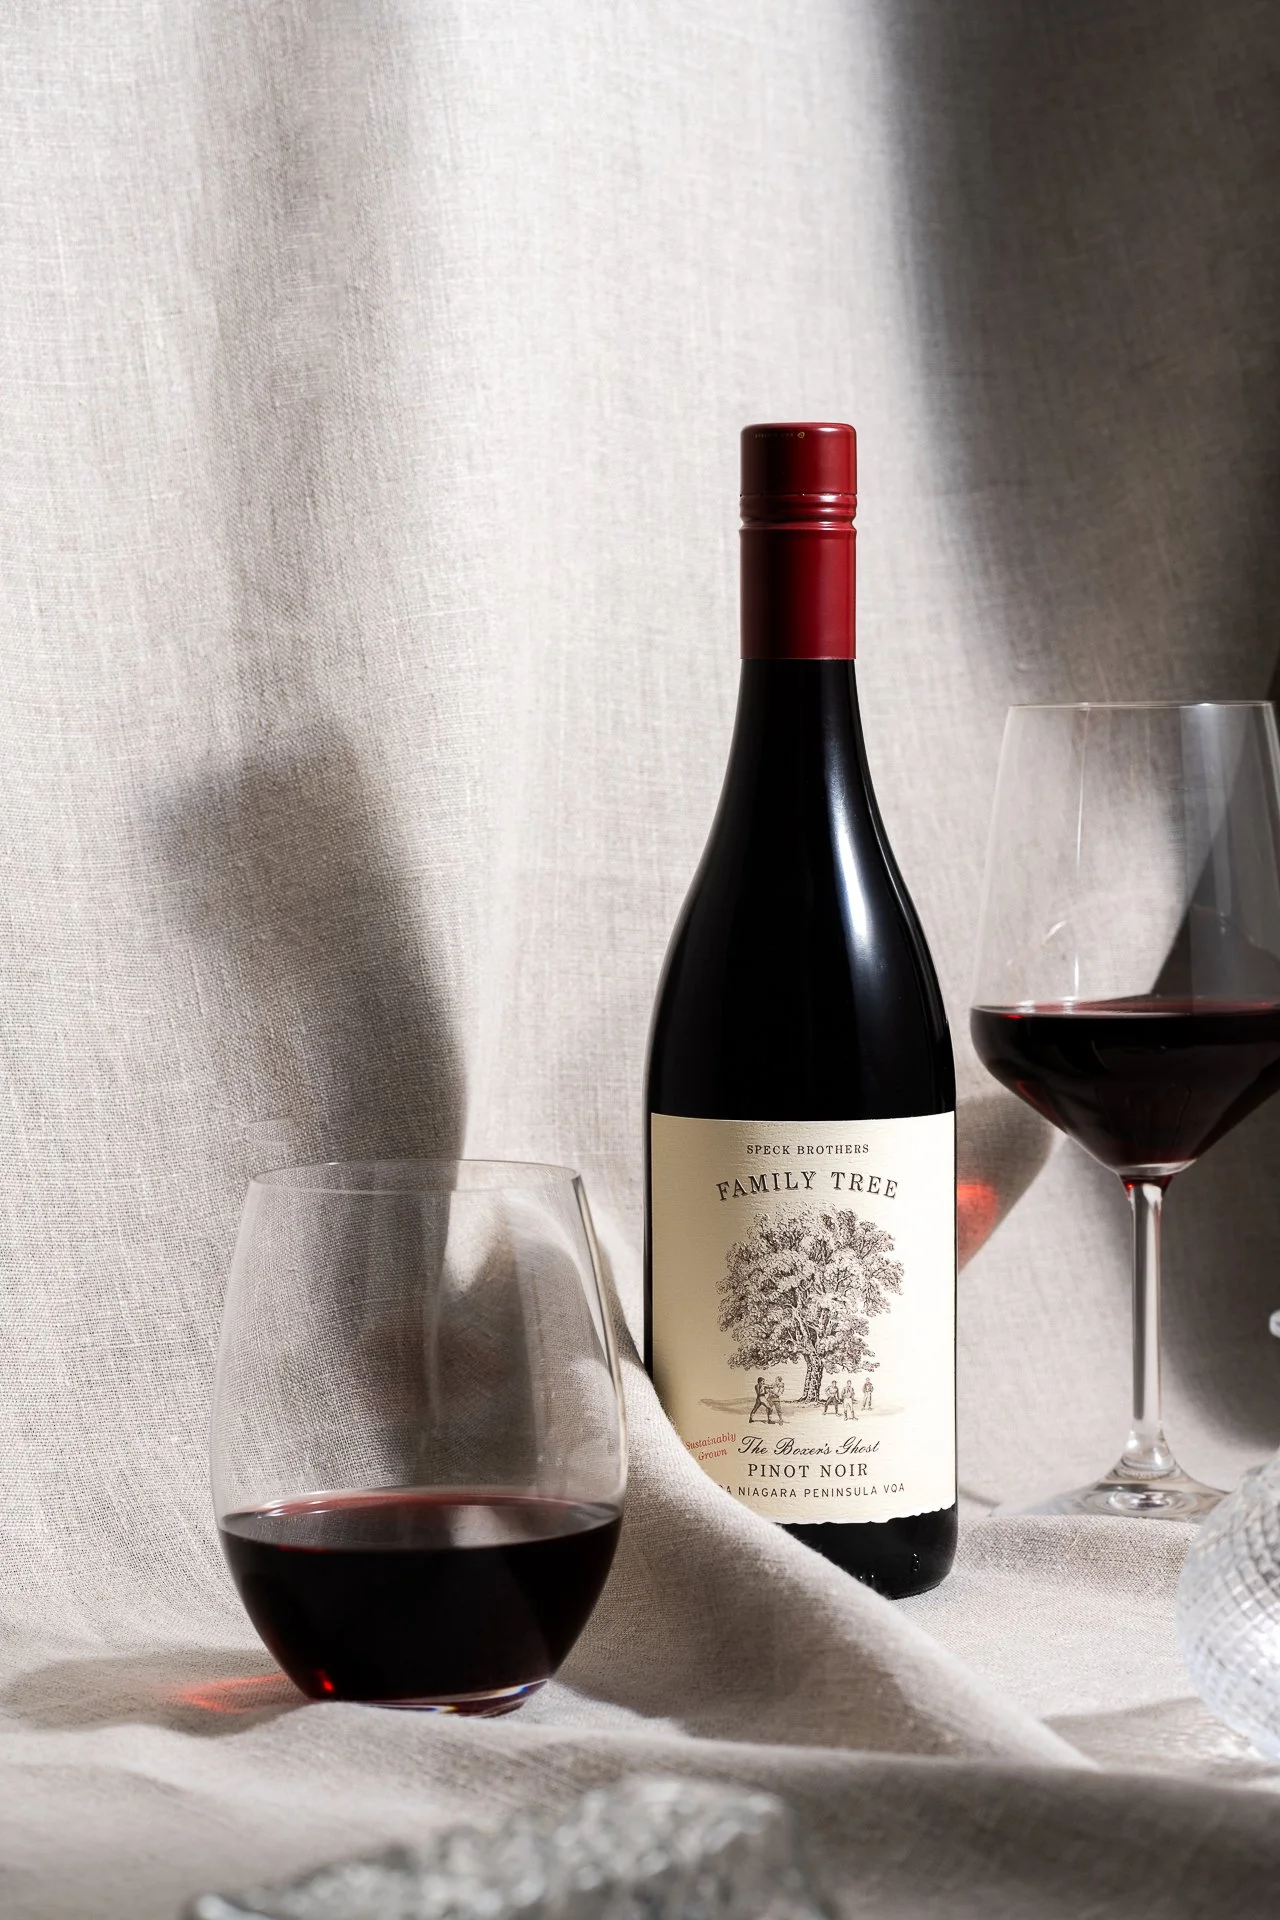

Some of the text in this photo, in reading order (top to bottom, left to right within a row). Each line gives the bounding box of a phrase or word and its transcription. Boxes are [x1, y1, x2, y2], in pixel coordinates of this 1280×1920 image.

[746, 1143, 870, 1155] SPECK BROTHERS
[716, 1170, 899, 1202] FAMILY TREE
[685, 1432, 737, 1450] Sustainably
[737, 1435, 881, 1456] The Boxer's Ghost
[697, 1449, 729, 1461] Grown
[747, 1462, 869, 1478] PINOT NOIR
[738, 1486, 797, 1498] NIAGARA
[804, 1484, 878, 1498] PENINSULA
[883, 1482, 905, 1494] VQA
